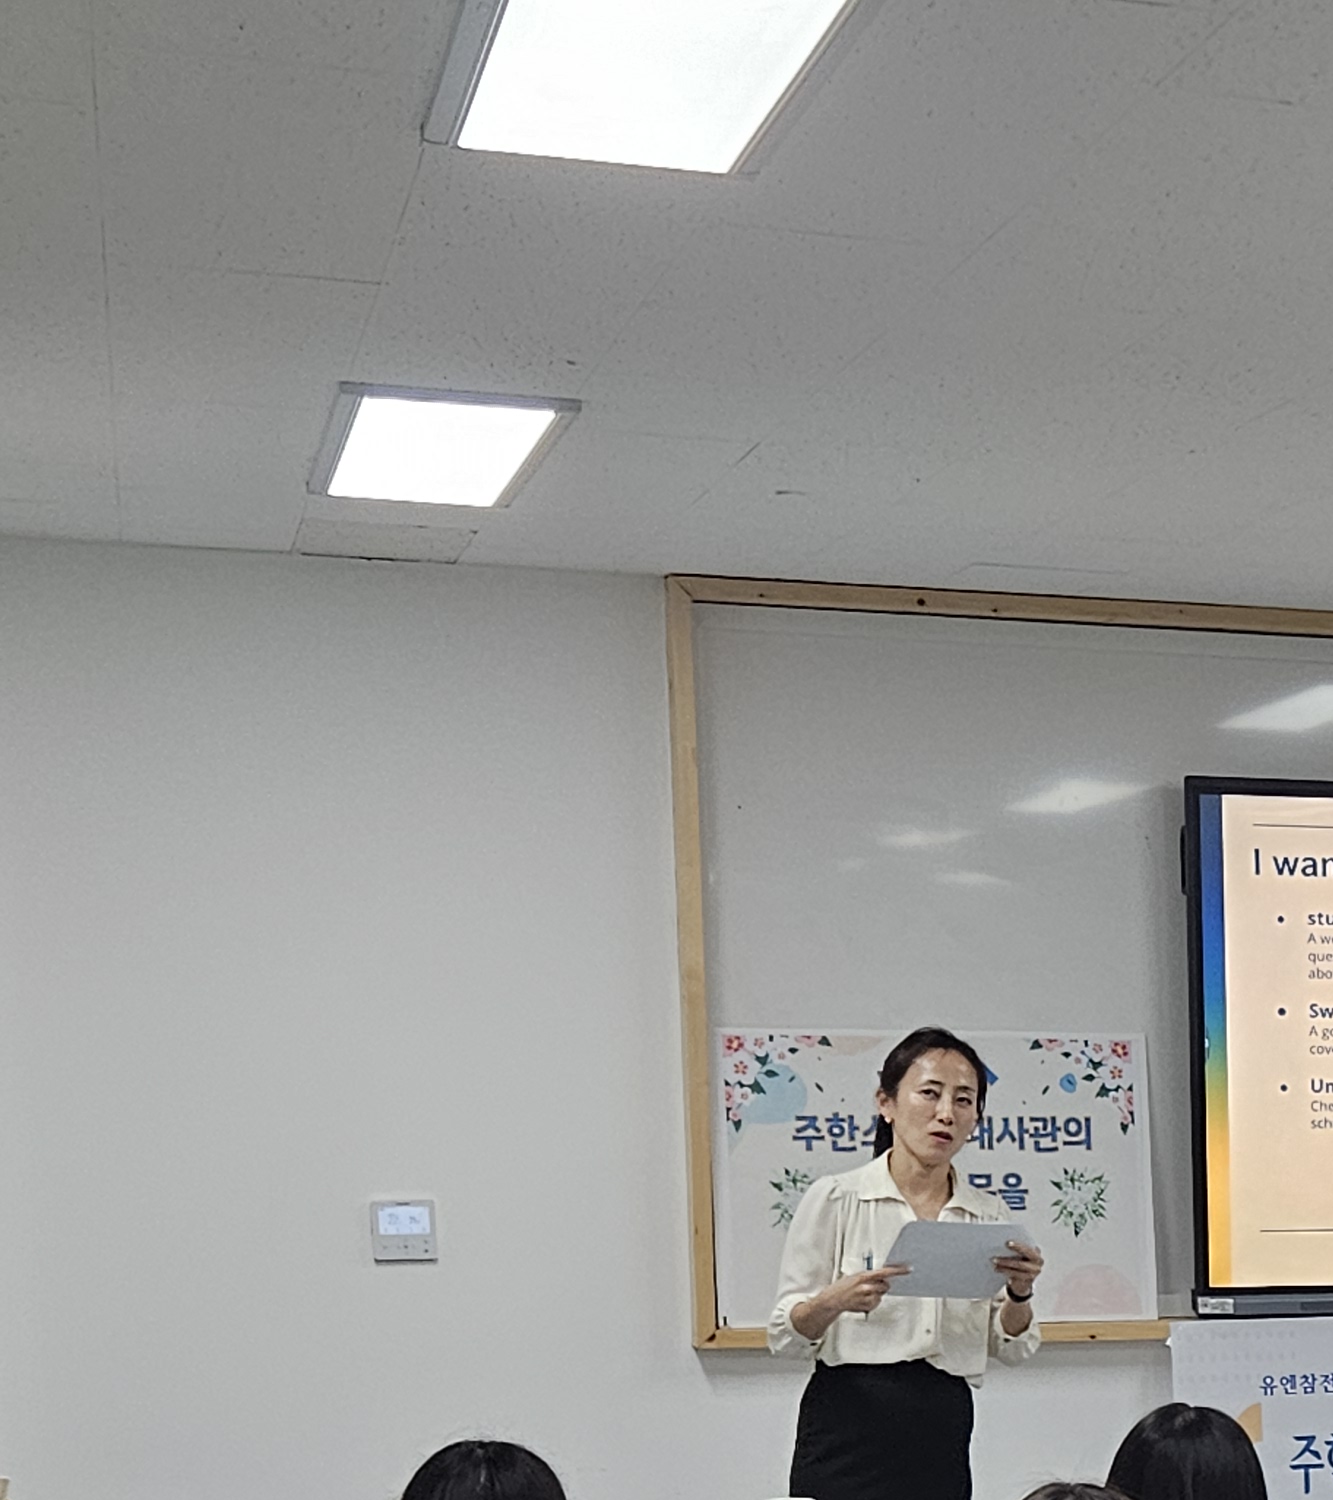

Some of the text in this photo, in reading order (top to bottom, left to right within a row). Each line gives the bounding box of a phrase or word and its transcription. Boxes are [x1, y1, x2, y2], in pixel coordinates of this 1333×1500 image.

[1254, 848, 1260, 876] I
[1307, 933, 1317, 944] A
[1309, 1025, 1318, 1036] A
